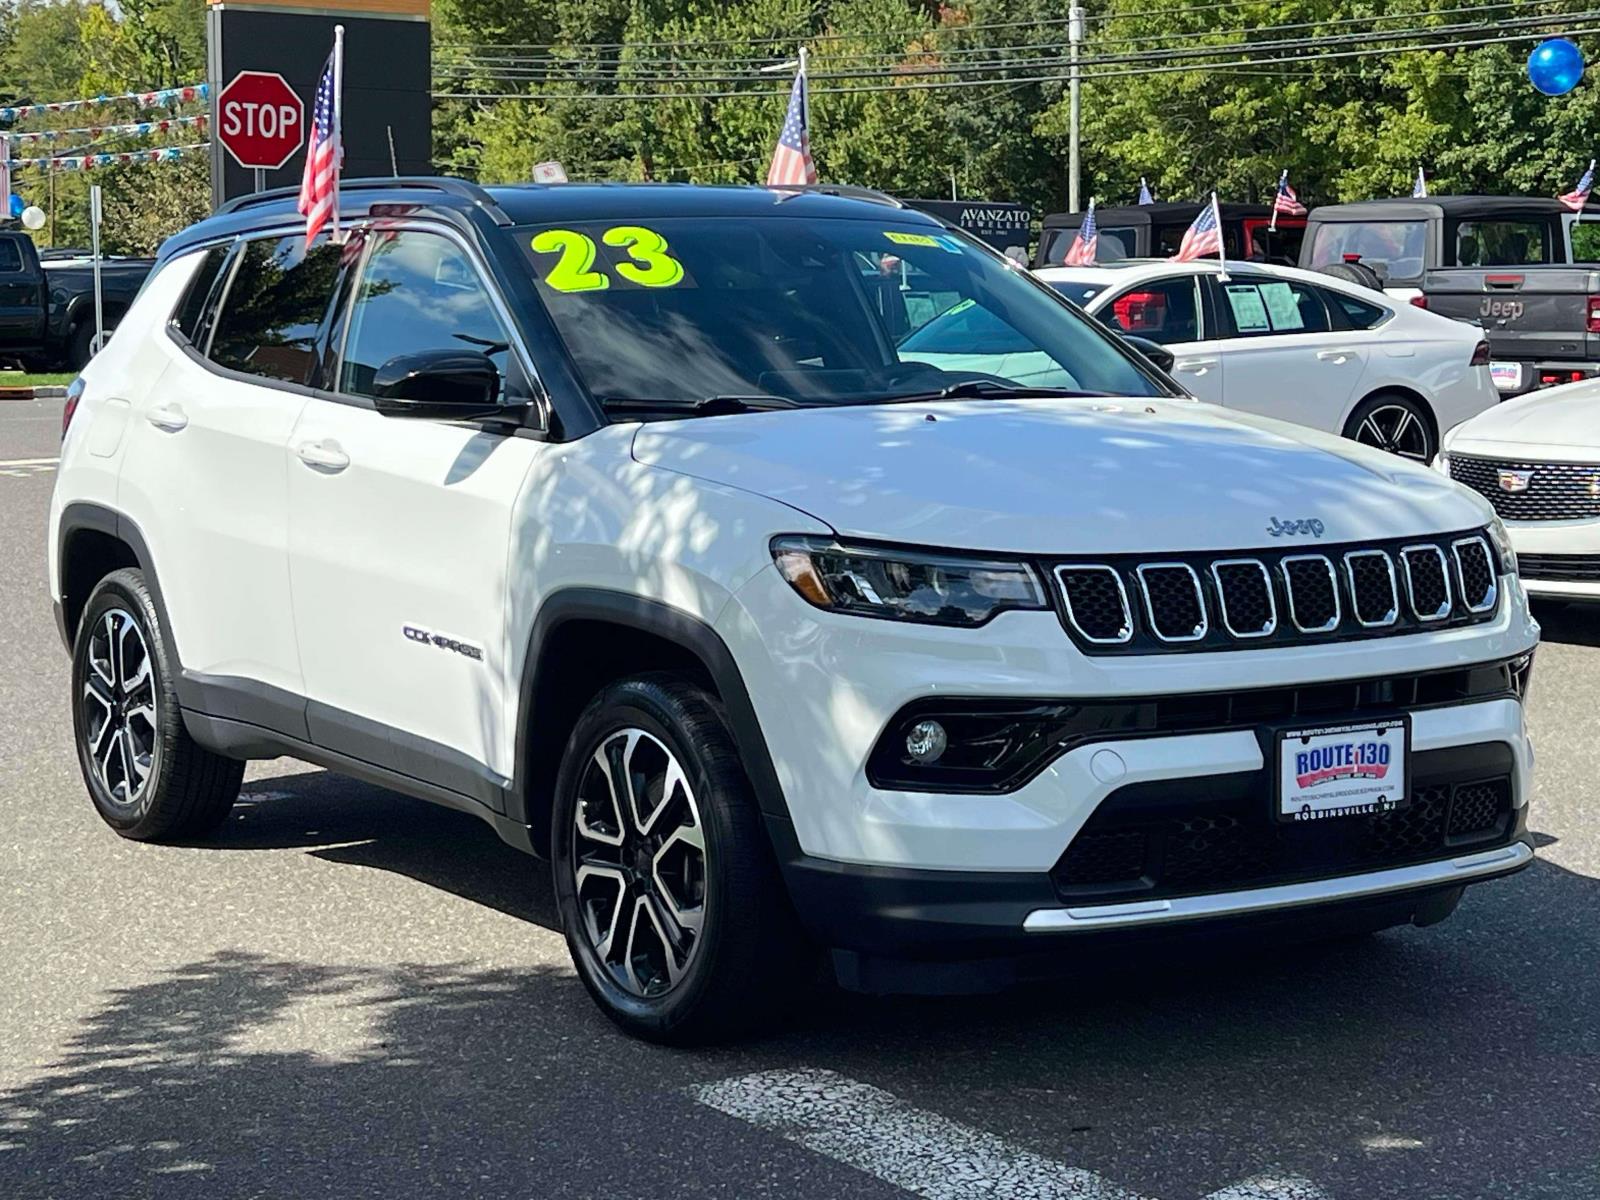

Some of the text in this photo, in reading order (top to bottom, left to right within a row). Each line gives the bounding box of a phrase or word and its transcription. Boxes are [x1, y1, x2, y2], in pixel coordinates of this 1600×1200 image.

[223, 101, 297, 139] STOP
[960, 208, 1031, 222] AVANZATO
[960, 220, 1030, 230] JEWELERS
[530, 226, 685, 293] 23
[1480, 297, 1524, 321] Jeep
[1265, 516, 1325, 538] Jeep
[403, 625, 484, 661] COMPASS
[1296, 742, 1391, 775] ROUTE 130
[1383, 801, 1396, 811] NJ
